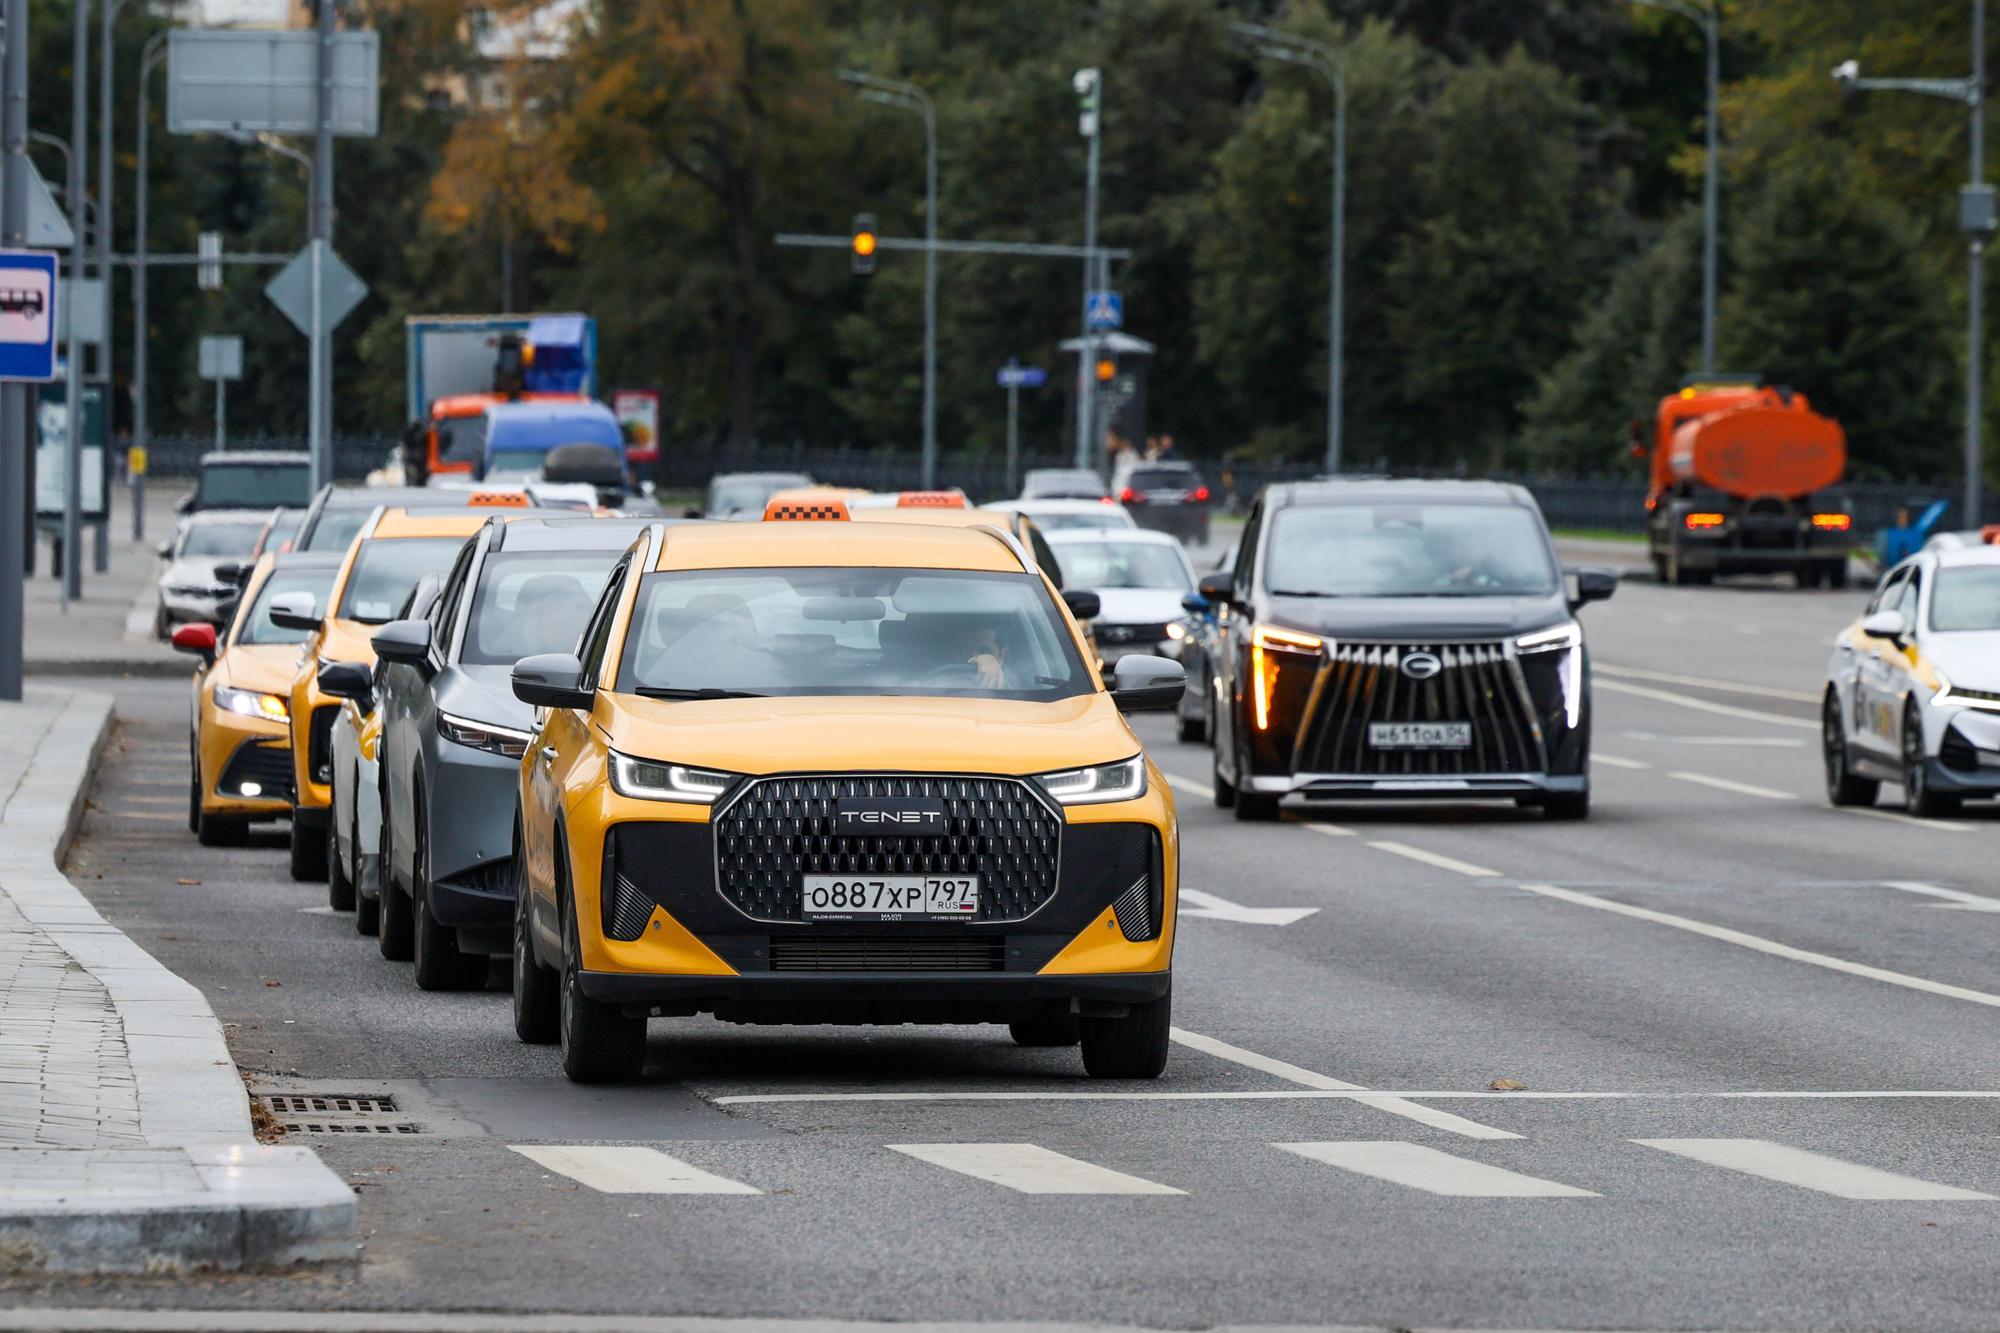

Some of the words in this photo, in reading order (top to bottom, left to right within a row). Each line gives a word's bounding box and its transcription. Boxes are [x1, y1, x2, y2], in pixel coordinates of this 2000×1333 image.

[840, 811, 941, 823] TENET
[811, 881, 922, 909] О887ХР
[928, 880, 970, 901] 797
[937, 901, 959, 910] RUS
